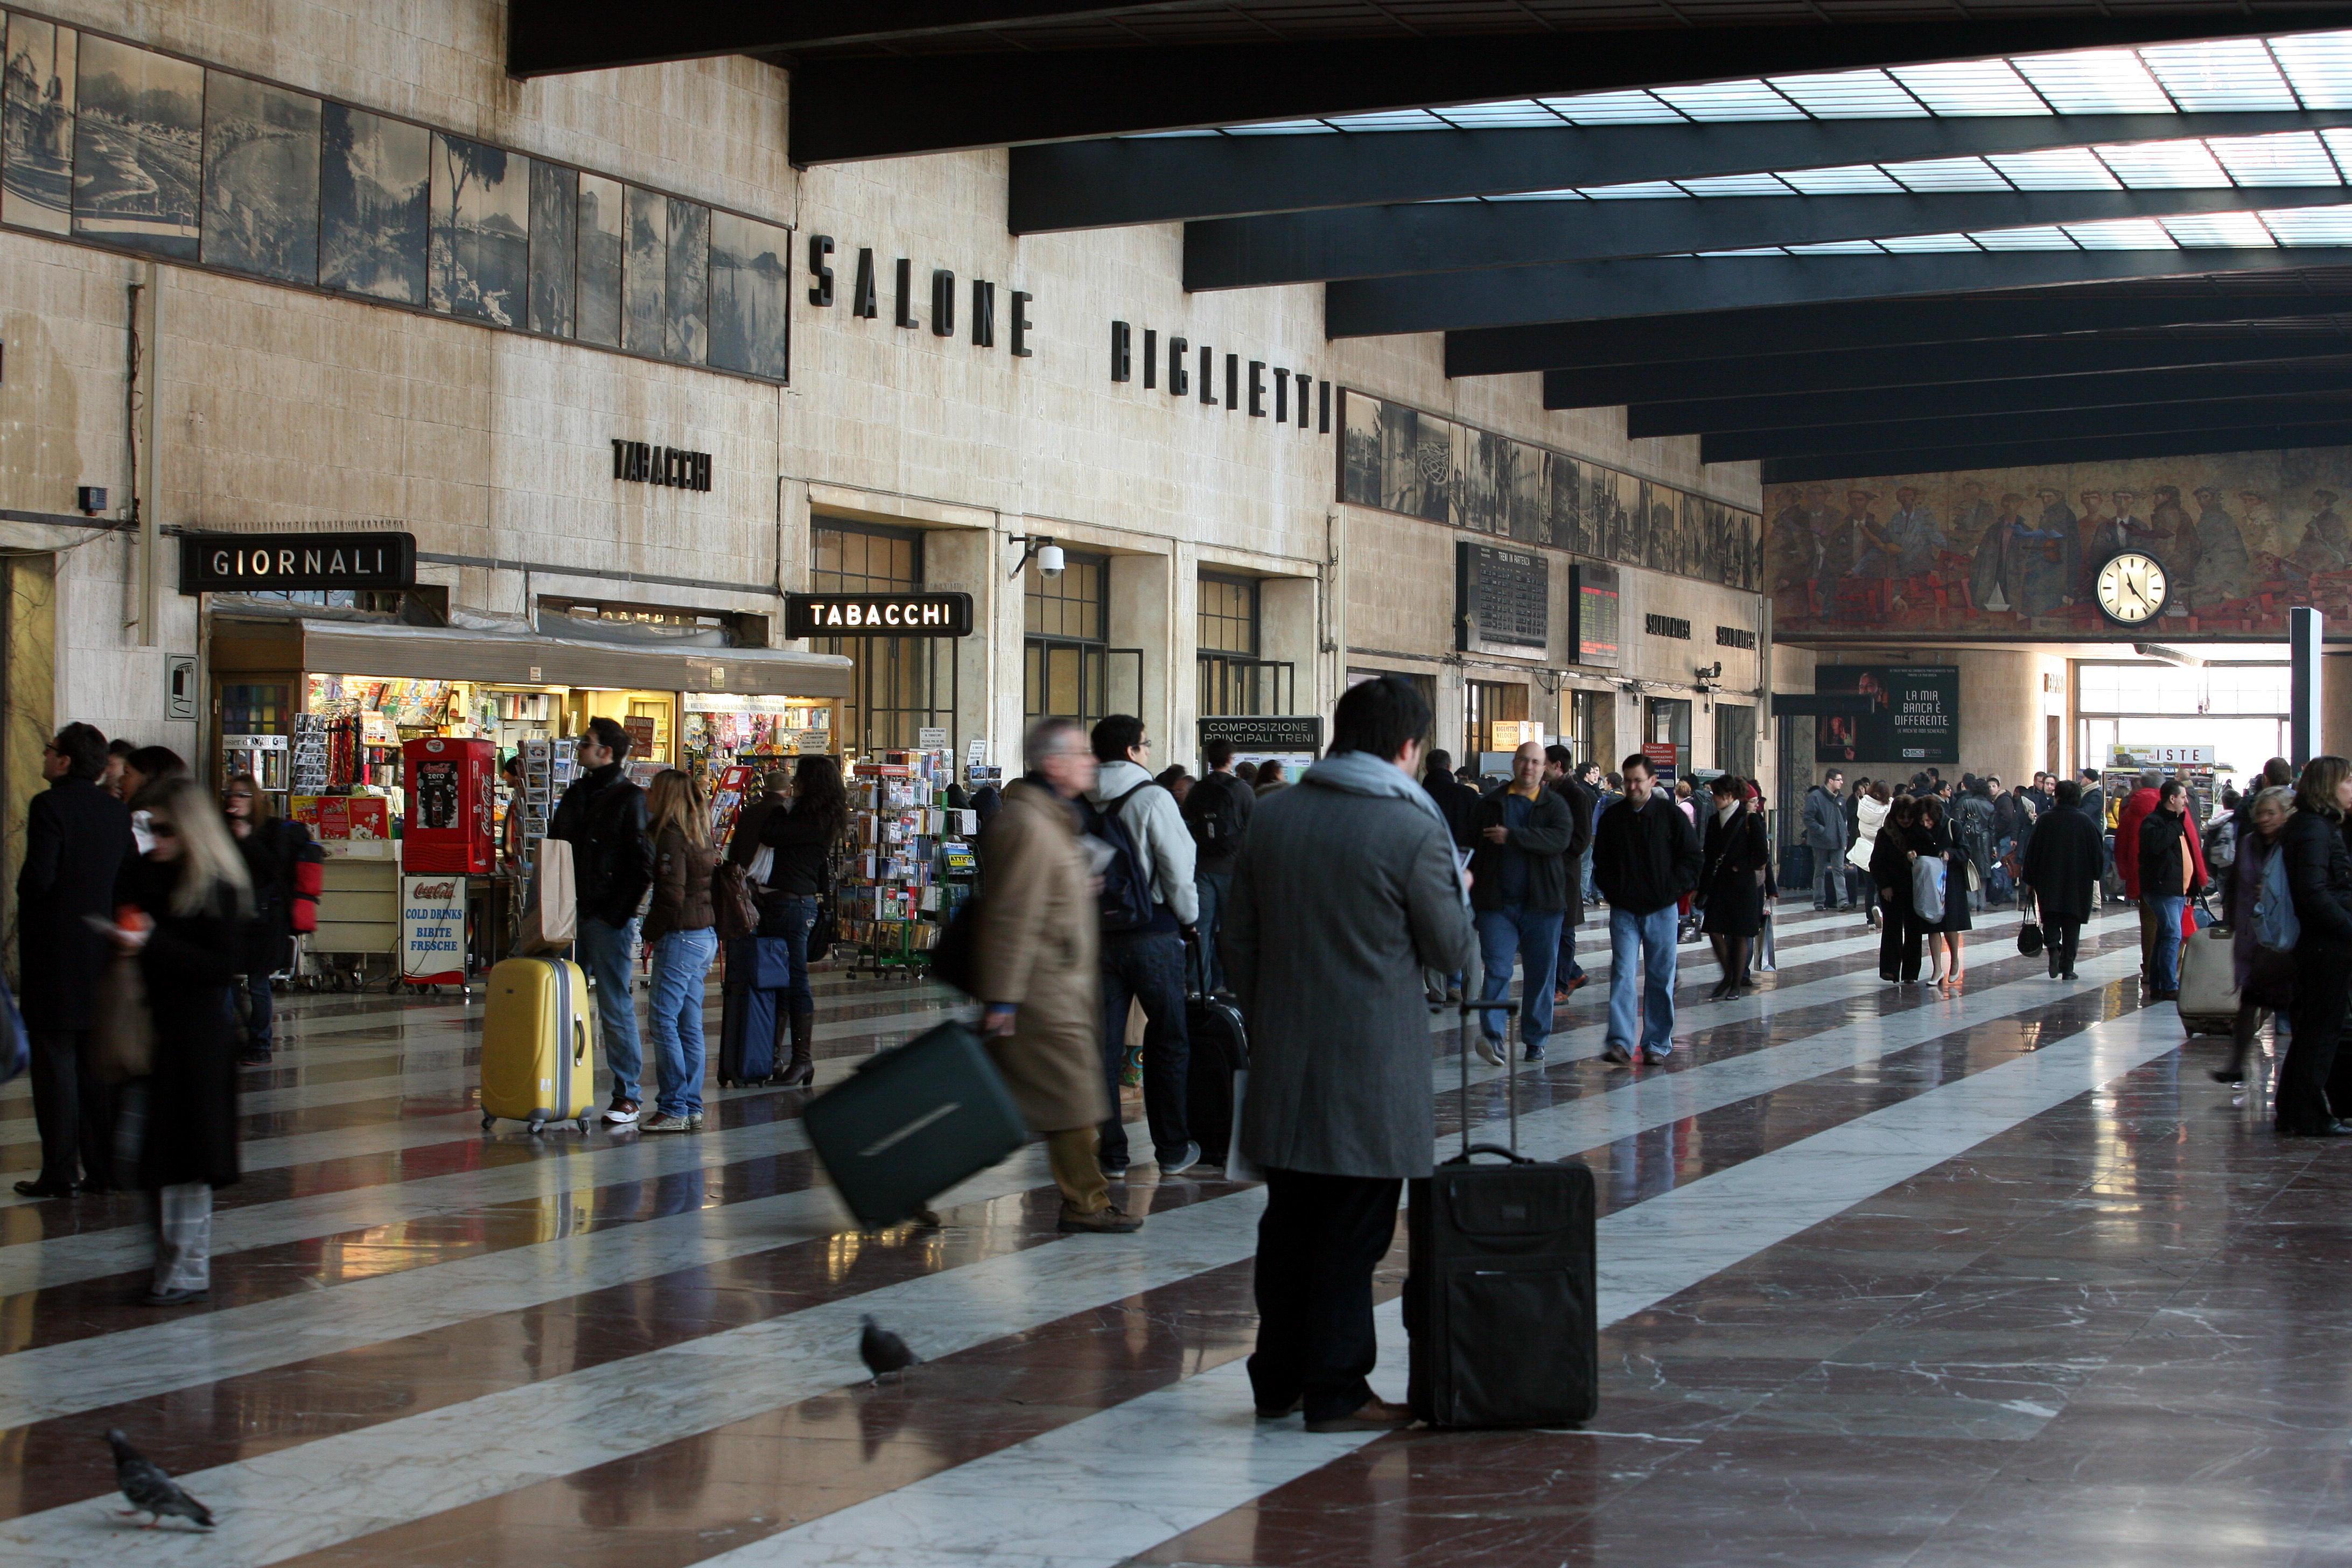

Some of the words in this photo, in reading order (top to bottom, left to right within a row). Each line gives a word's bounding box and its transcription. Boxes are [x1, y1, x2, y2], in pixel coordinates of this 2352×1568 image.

[809, 235, 1033, 358] SALONE
[1112, 321, 1331, 433] BIGLIETTI
[213, 549, 382, 575] GIORNALI
[1498, 551, 1508, 562] TRENI
[1509, 554, 1513, 563] IN
[1514, 555, 1530, 566] PARTENZA
[810, 604, 949, 625] TABACCHI
[1906, 691, 1917, 701] LA
[1921, 691, 1938, 701] MIA
[1903, 703, 1932, 713] BANCA
[1936, 701, 1941, 713] È
[1895, 715, 1949, 726] DIFFERENTE.
[1209, 723, 1308, 732] COMPOSIZIONE
[1278, 734, 1314, 742] TRENI
[481, 772, 492, 836] Coca-Cola
[414, 882, 454, 899] Coca-Cola
[405, 908, 428, 920] COLD
[430, 908, 462, 920] DRINKS
[416, 927, 452, 937] BIBITE
[410, 941, 458, 951] FRESCHE
